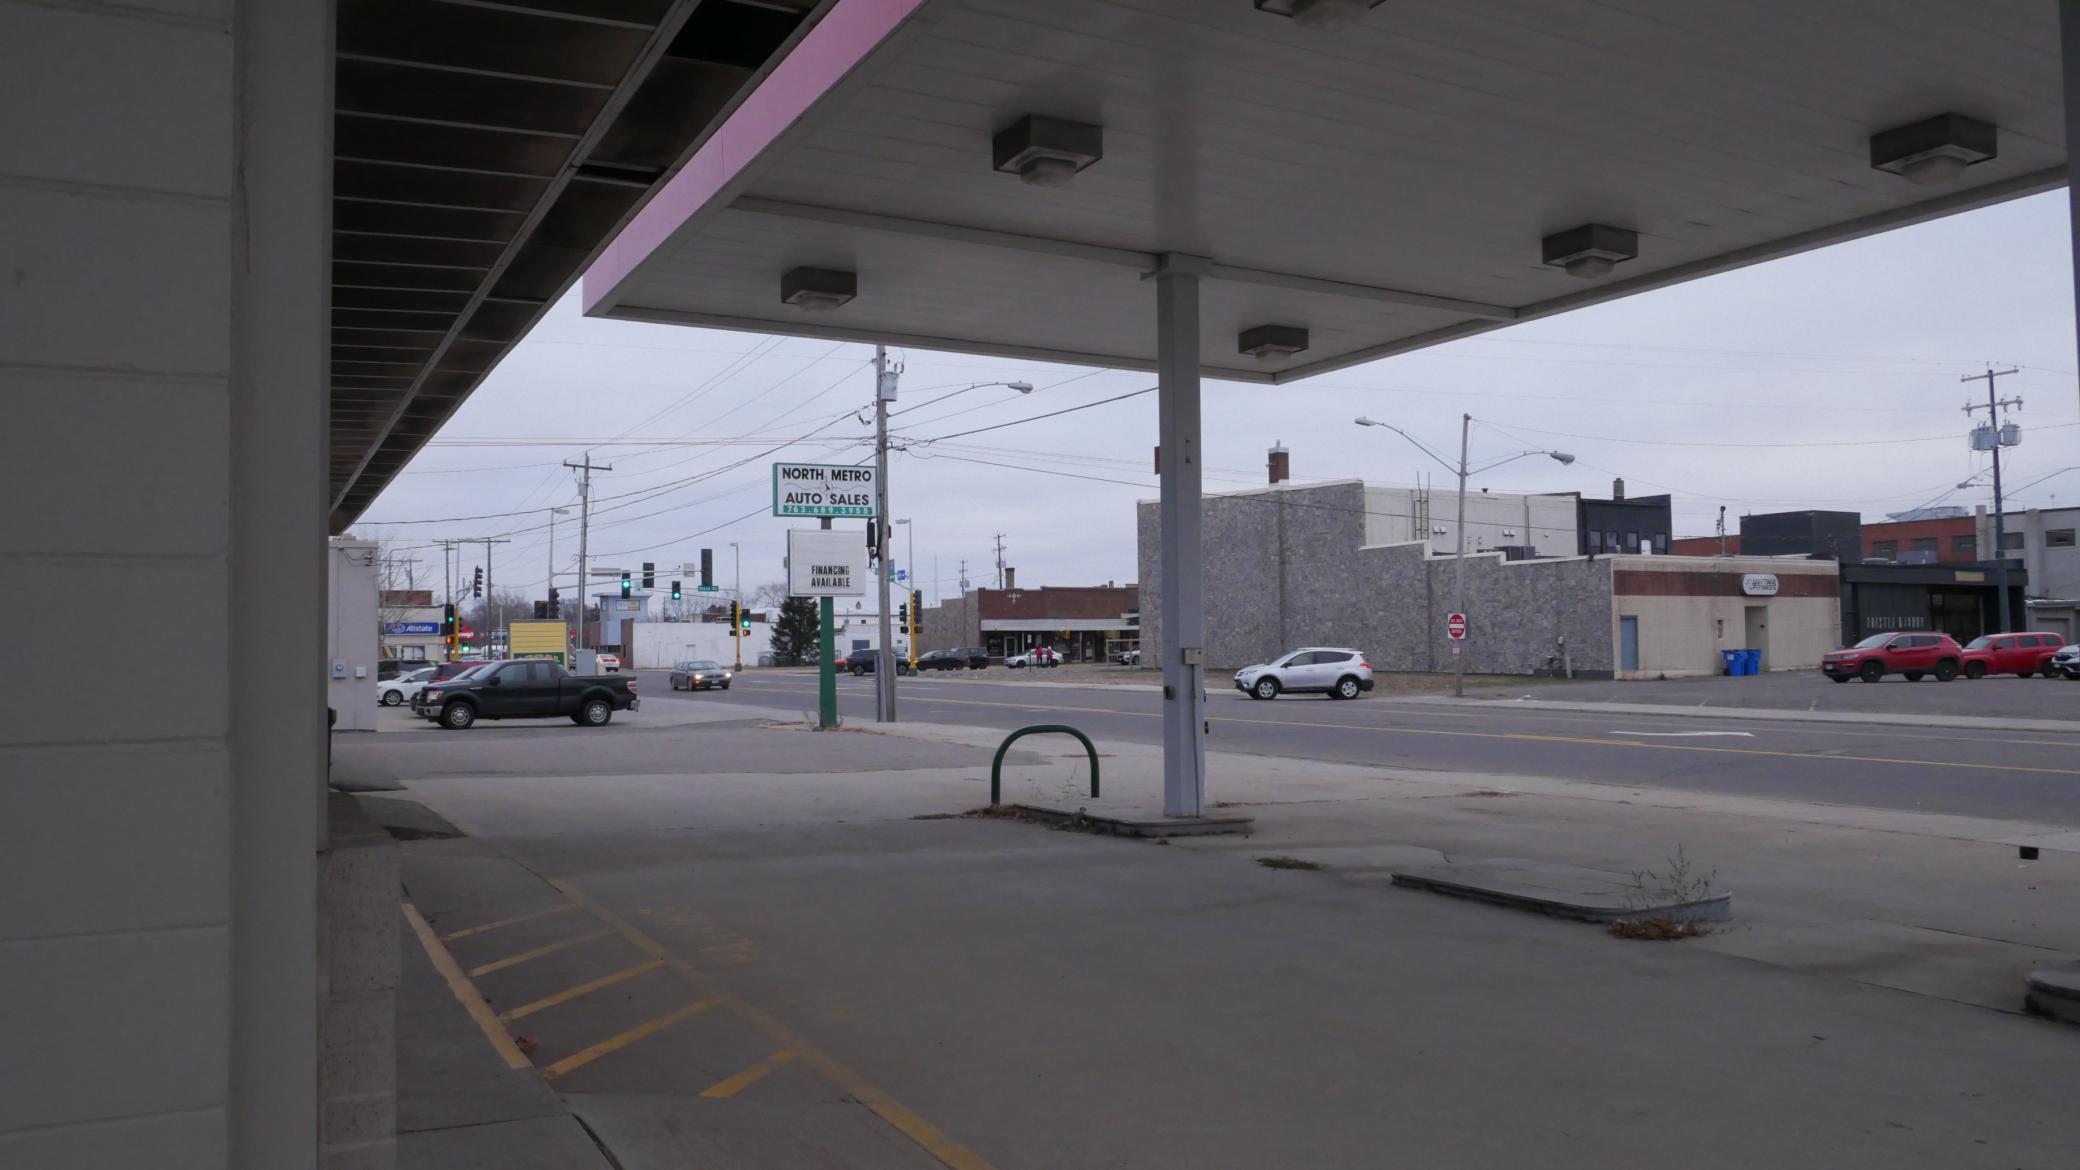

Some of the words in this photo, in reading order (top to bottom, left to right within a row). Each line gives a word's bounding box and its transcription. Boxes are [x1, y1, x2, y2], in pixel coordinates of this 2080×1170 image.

[782, 467, 824, 480] NORTH
[831, 469, 872, 482] METRO
[785, 492, 822, 505] AUTO
[829, 494, 869, 506] SALES
[811, 565, 850, 576] FINANCING
[811, 577, 850, 588] AVAILABLE
